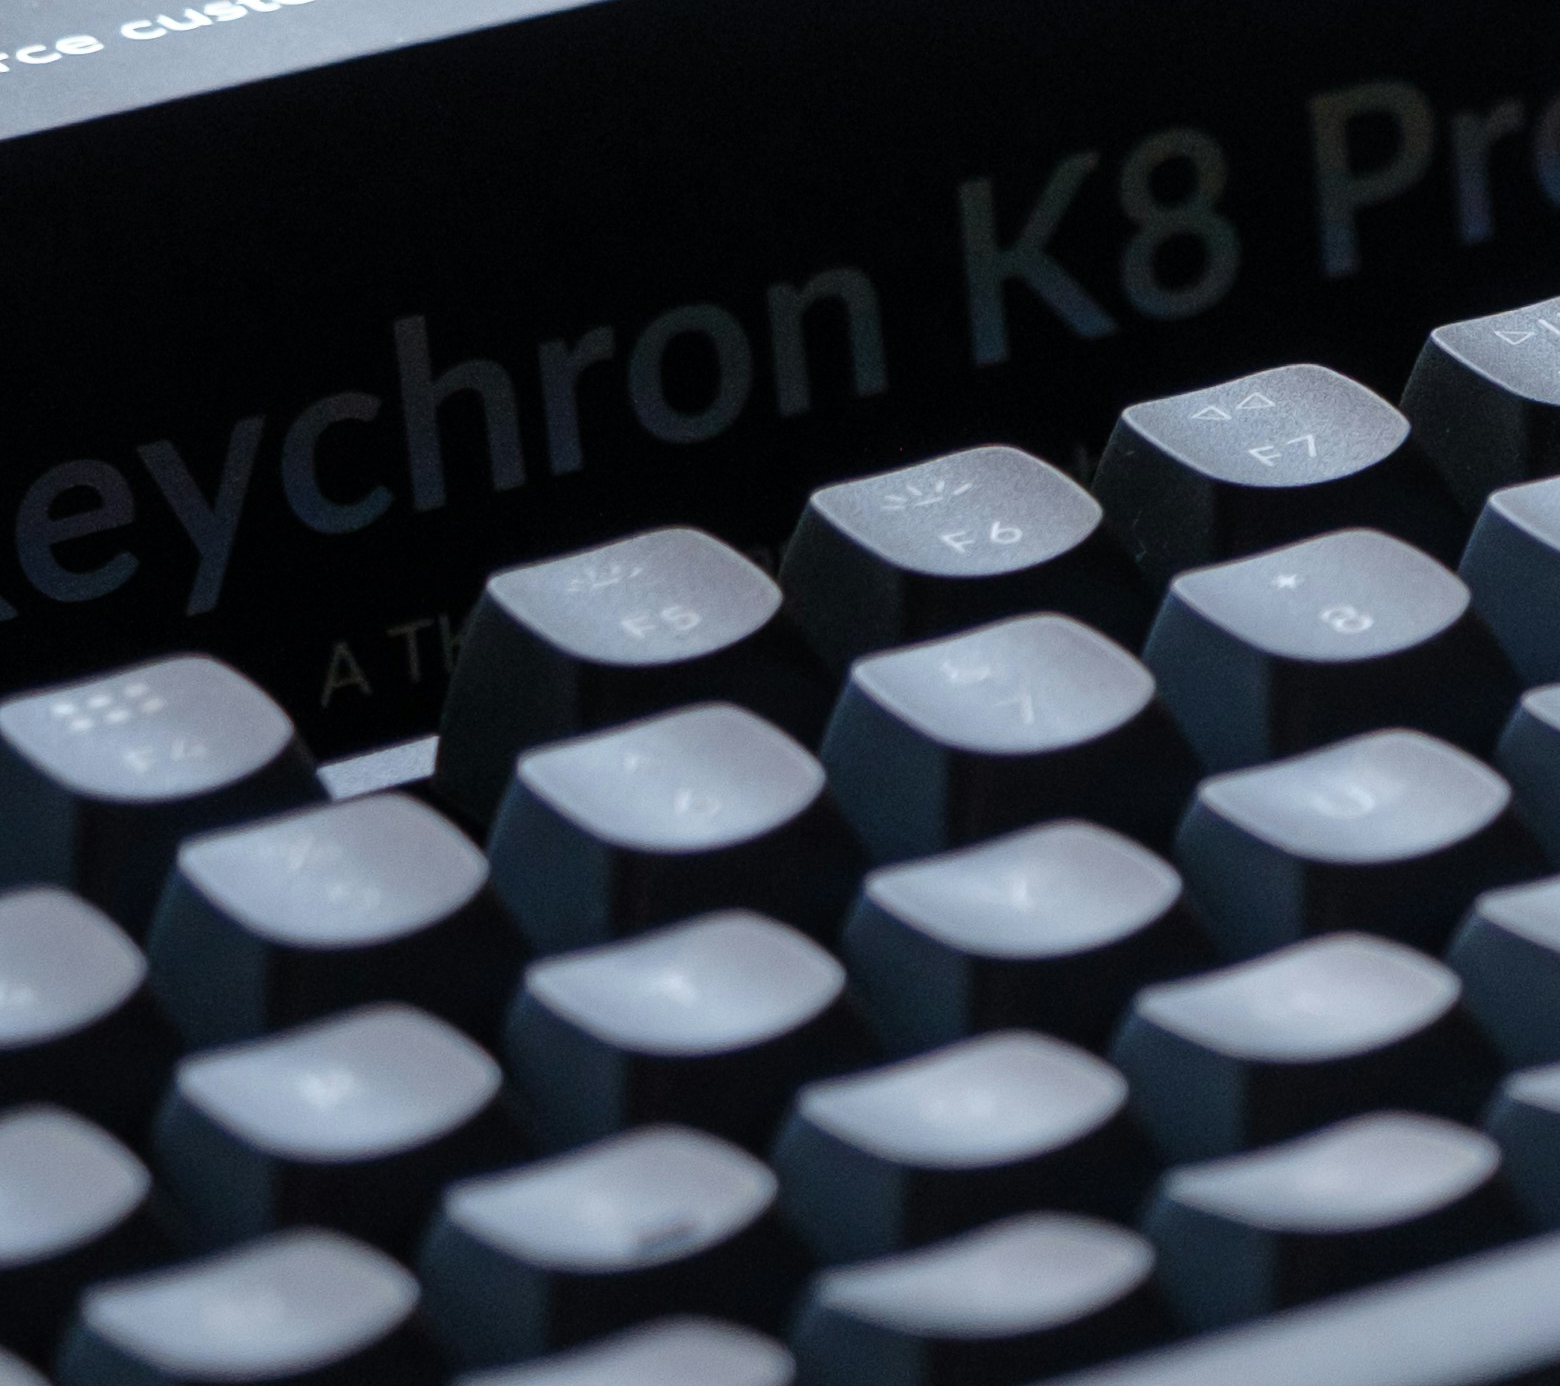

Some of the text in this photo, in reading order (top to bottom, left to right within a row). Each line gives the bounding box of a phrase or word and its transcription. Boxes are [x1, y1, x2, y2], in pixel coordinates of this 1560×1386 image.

[0, 263, 890, 615] eychron
[954, 126, 1245, 371] K8
[1247, 434, 1318, 467] F7
[940, 520, 1023, 553] F6
[319, 638, 374, 710] A
